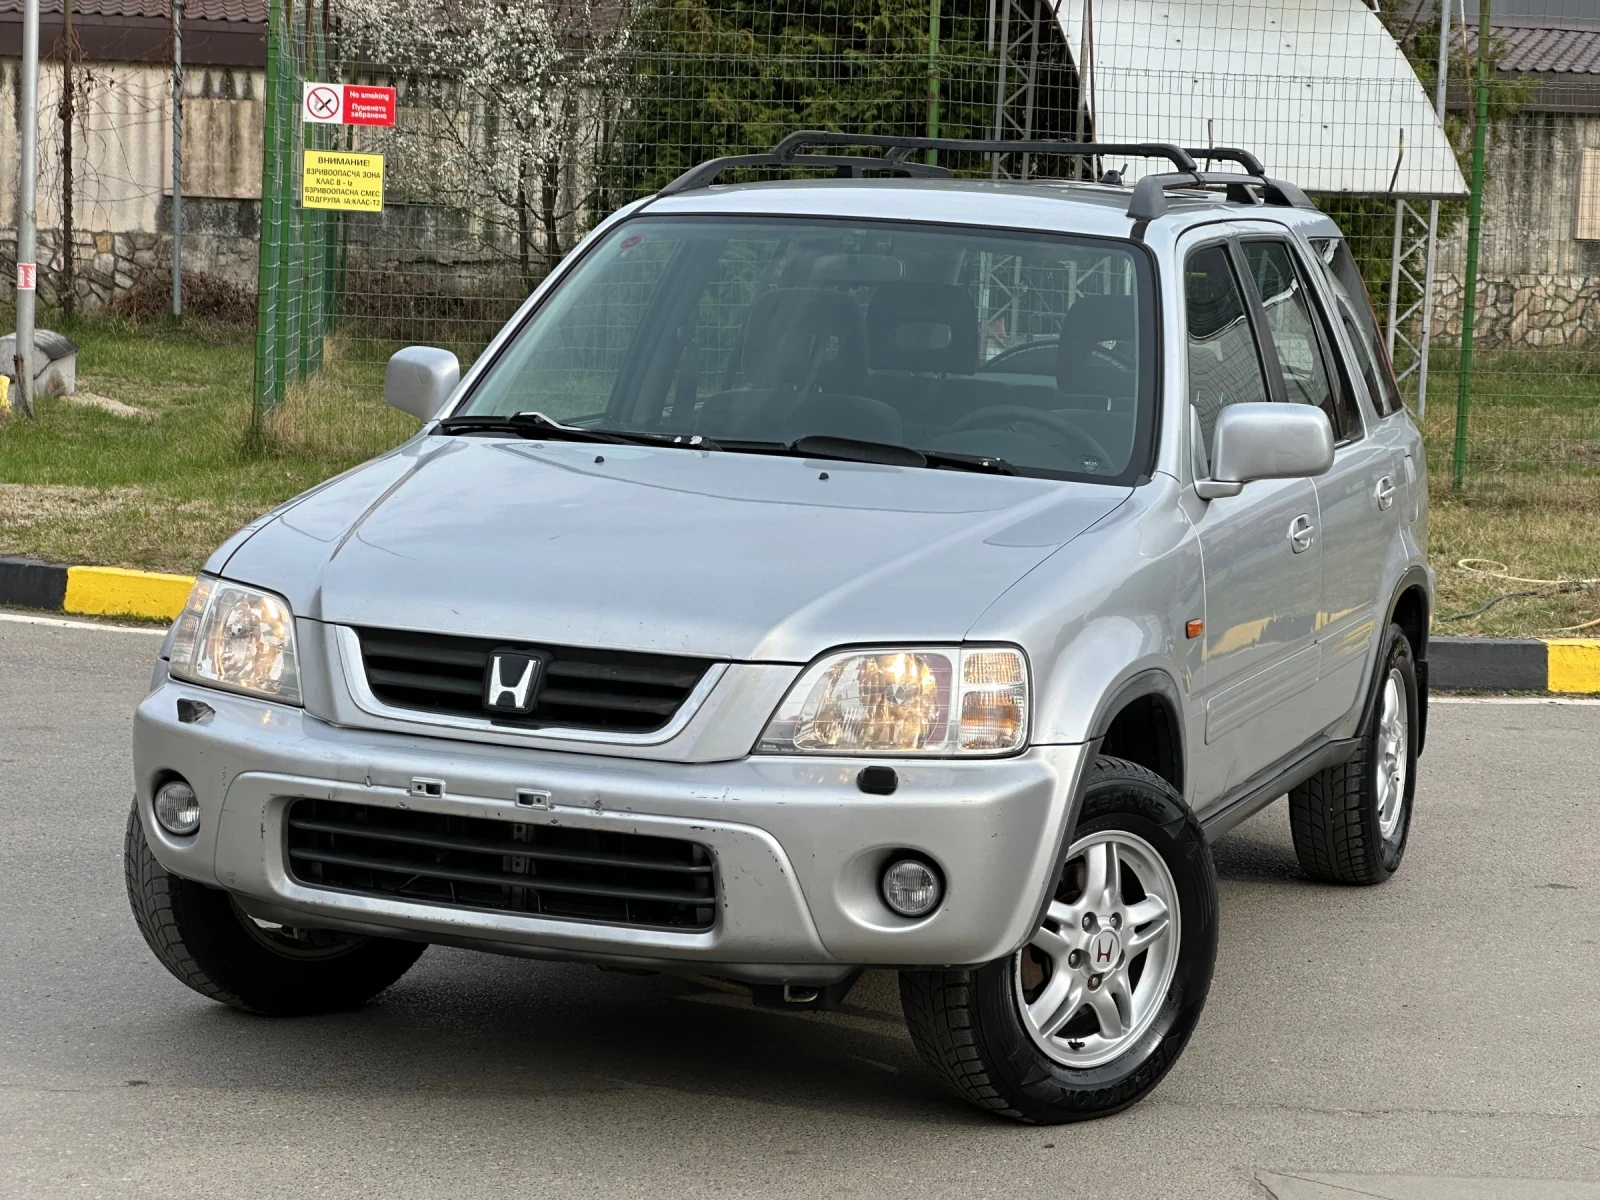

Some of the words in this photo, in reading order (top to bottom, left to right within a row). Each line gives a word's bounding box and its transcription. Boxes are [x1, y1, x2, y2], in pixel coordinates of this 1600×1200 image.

[350, 90, 359, 98] No
[361, 92, 389, 102] smoking
[352, 103, 386, 112] Пушенето
[351, 111, 387, 119] забранено
[318, 156, 370, 167] ВНИМАНИЕ!
[362, 171, 381, 179] ЗОНА
[316, 178, 335, 186] КЛАС
[304, 186, 359, 196] ВЗРИВООПАСНА
[305, 195, 341, 204] ПОДГРУПА
[488, 656, 536, 709] H
